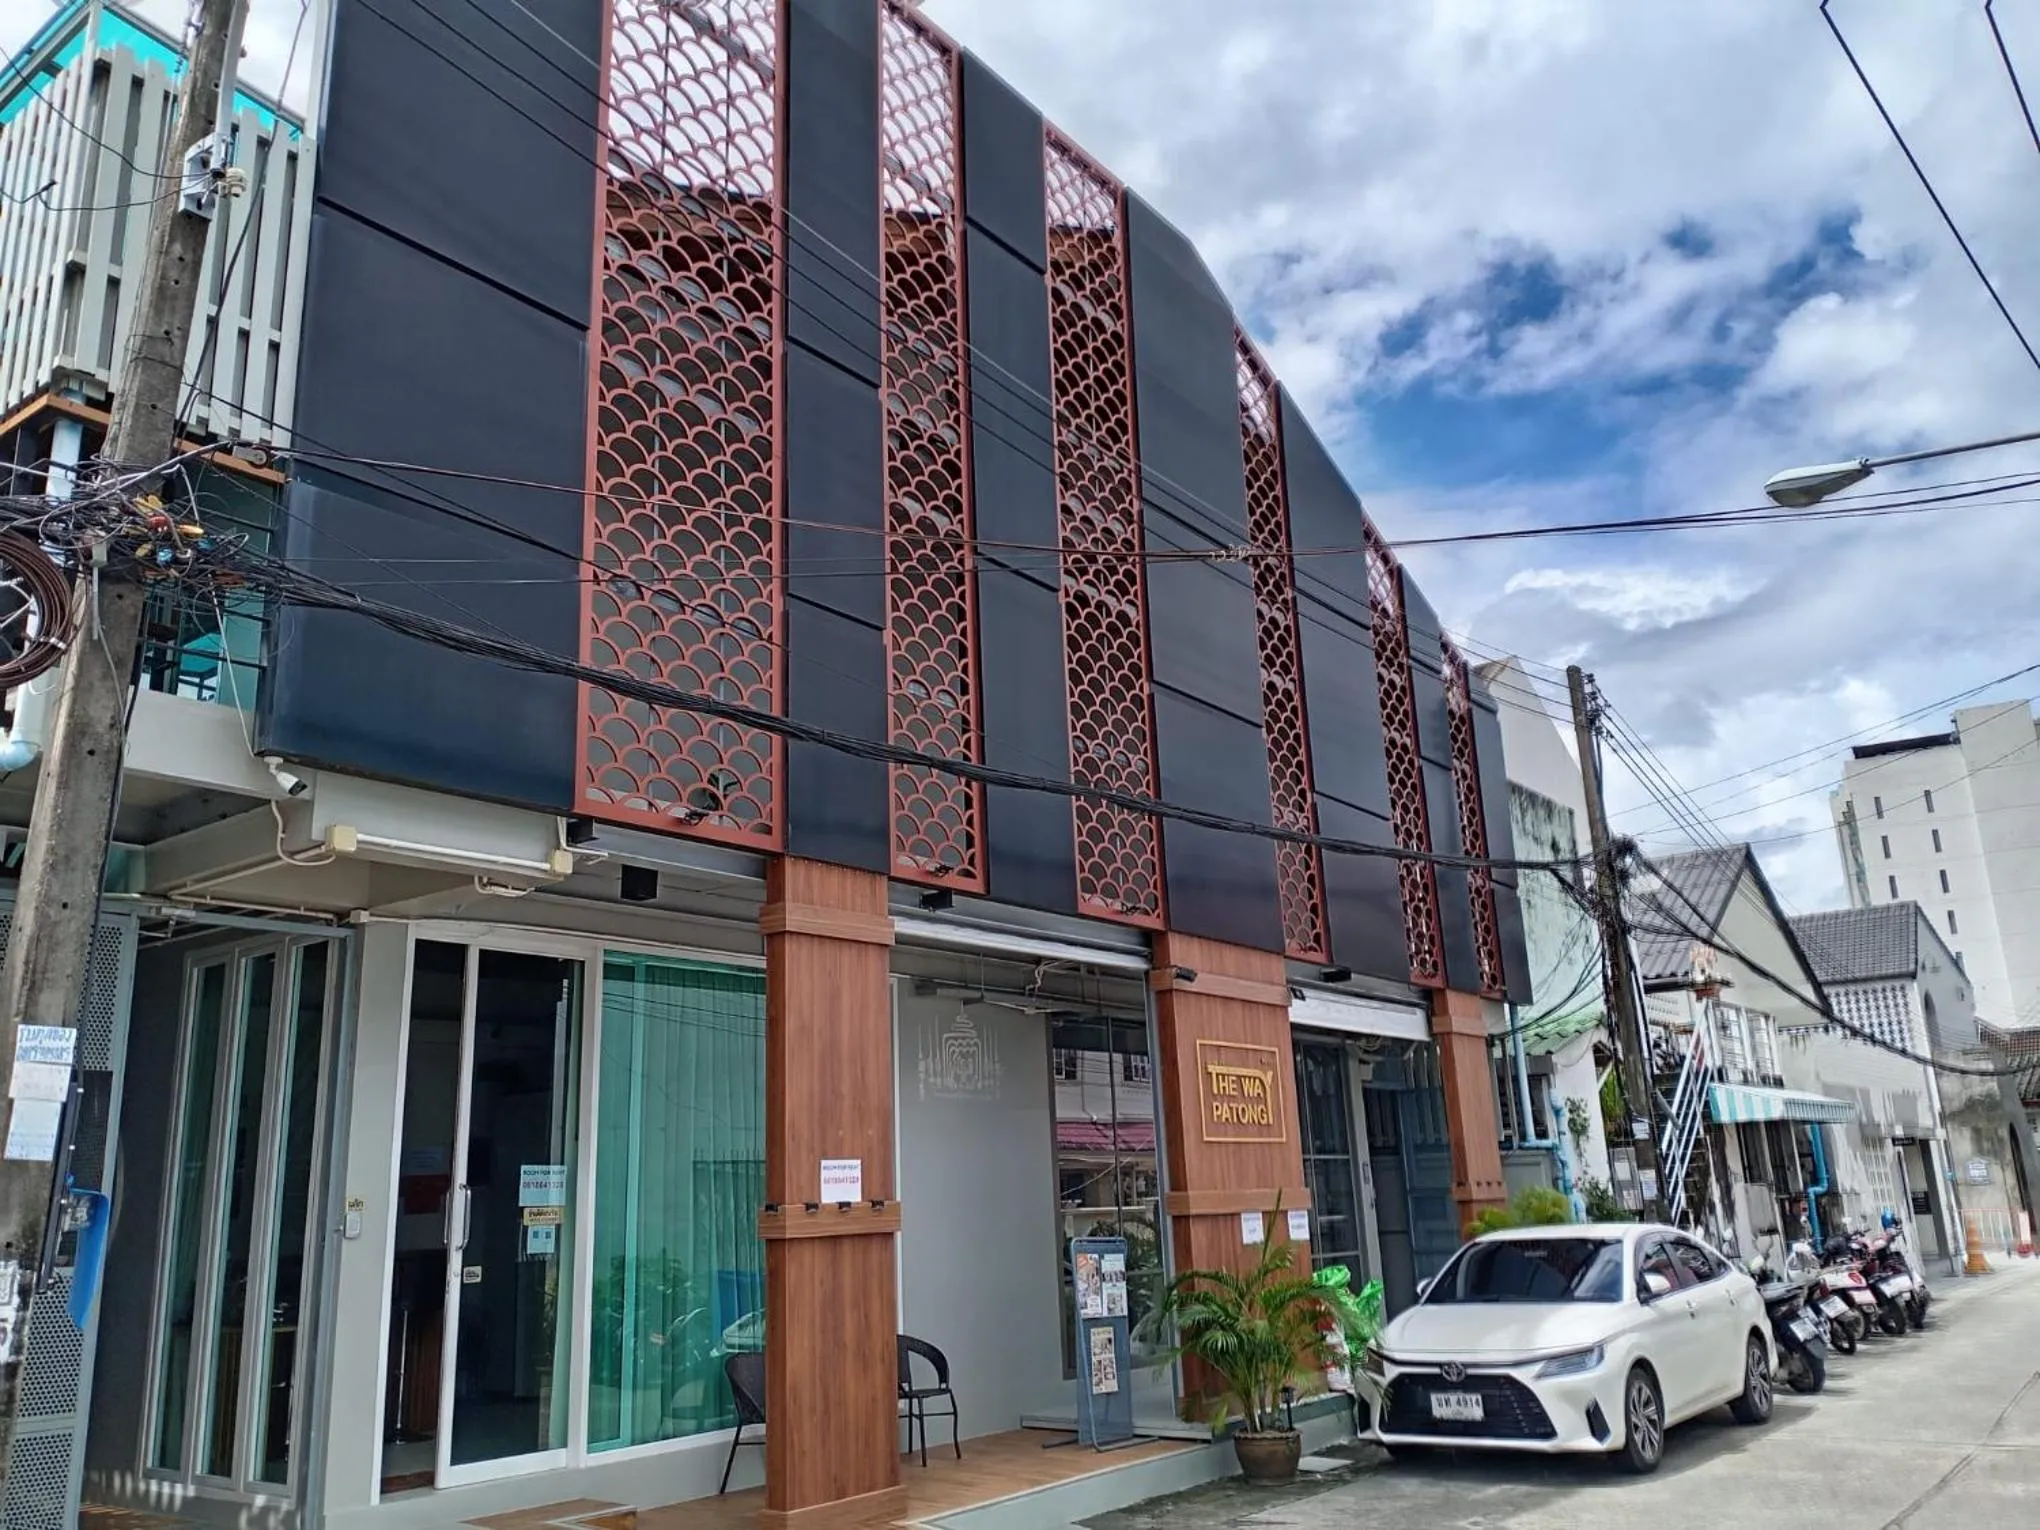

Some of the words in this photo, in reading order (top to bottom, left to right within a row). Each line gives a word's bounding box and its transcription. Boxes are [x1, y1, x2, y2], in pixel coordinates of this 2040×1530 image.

[1207, 1064, 1238, 1096] THE
[1241, 1069, 1273, 1124] WAY
[1212, 1101, 1267, 1125] PATONG
